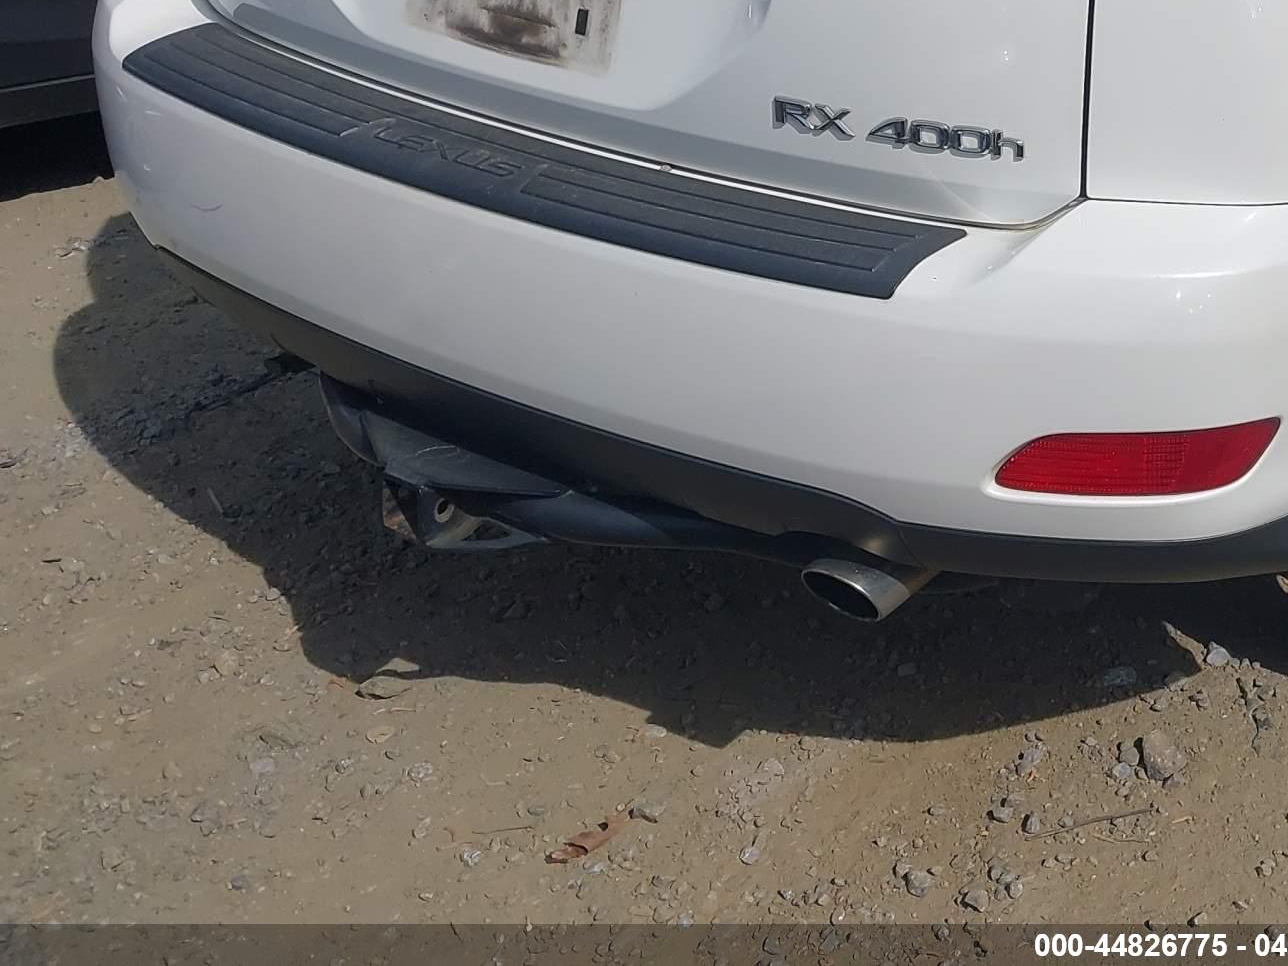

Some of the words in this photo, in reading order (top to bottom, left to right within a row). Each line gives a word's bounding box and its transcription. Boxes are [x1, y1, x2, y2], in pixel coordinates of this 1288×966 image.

[373, 126, 523, 178] LEXUS
[772, 95, 856, 141] RX
[865, 116, 1024, 162] 400h
